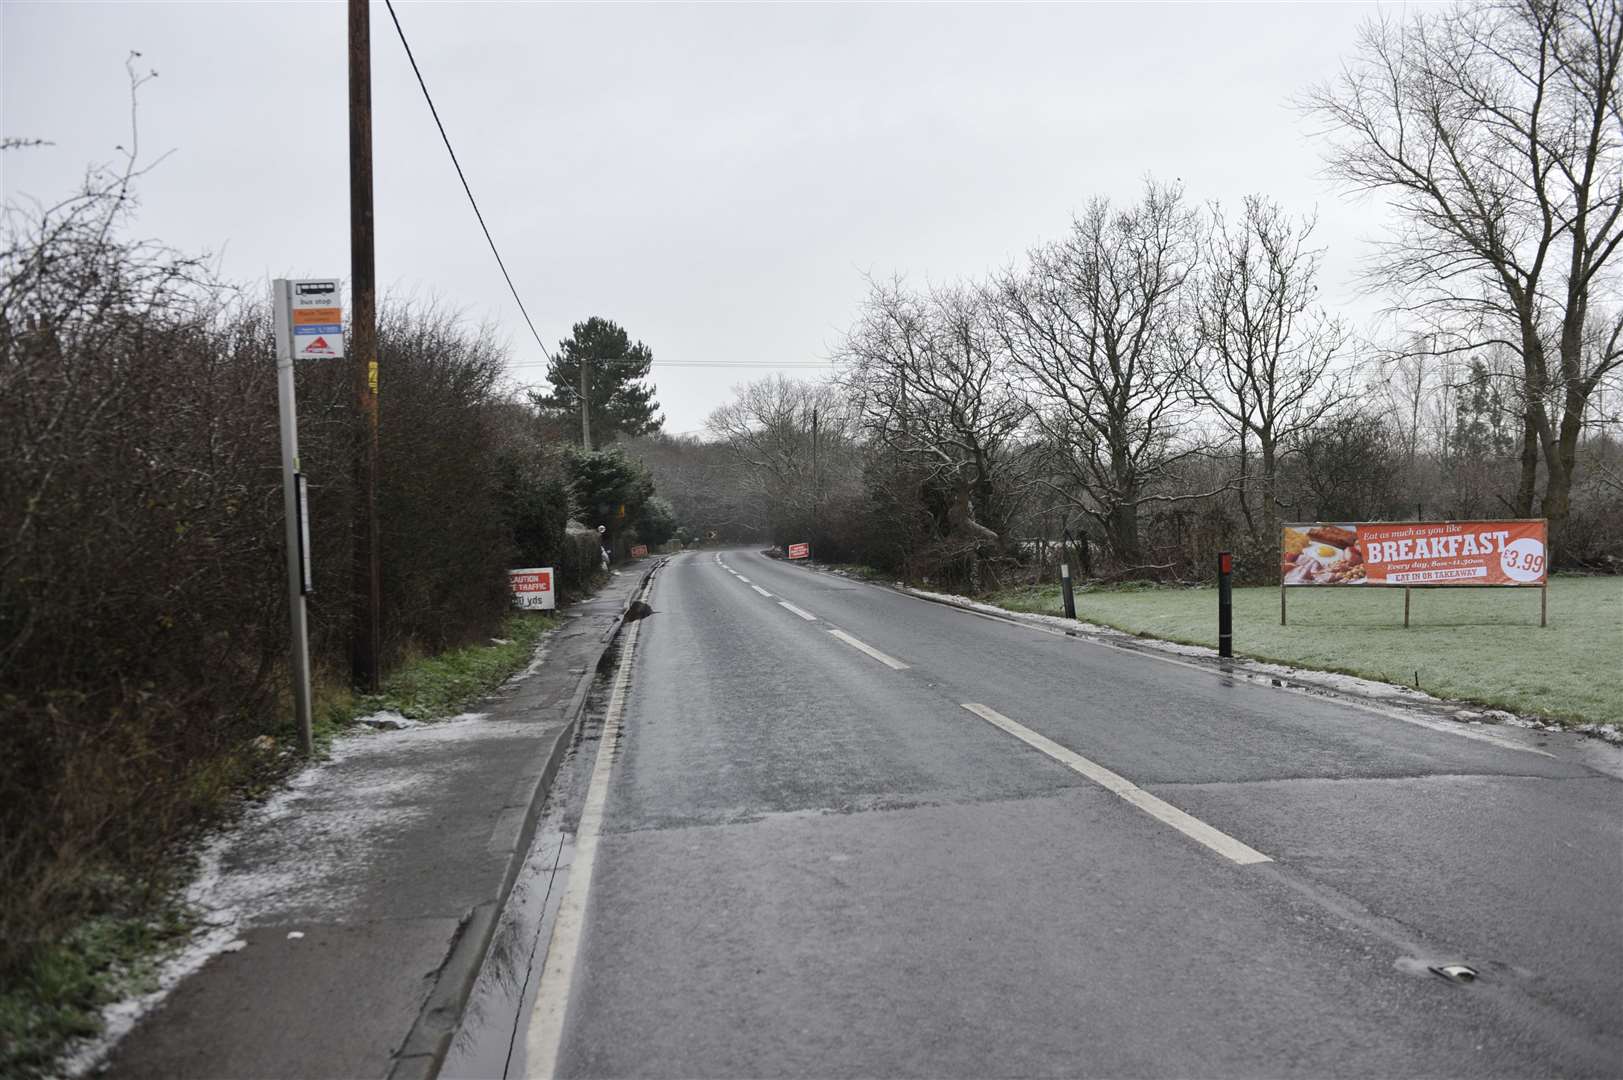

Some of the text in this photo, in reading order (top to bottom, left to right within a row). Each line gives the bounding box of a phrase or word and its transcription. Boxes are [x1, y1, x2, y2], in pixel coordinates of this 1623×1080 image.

[1364, 532, 1378, 540] Eat
[1391, 528, 1414, 538] much
[1428, 527, 1444, 536] you
[1446, 524, 1462, 533] like
[1367, 531, 1509, 564] BREAKFAST
[1387, 562, 1410, 571] Every
[1395, 574, 1412, 582] EAT
[1435, 568, 1478, 579] TAKEAWAY
[519, 582, 547, 591] TRAFFIC
[526, 596, 543, 607] yds
